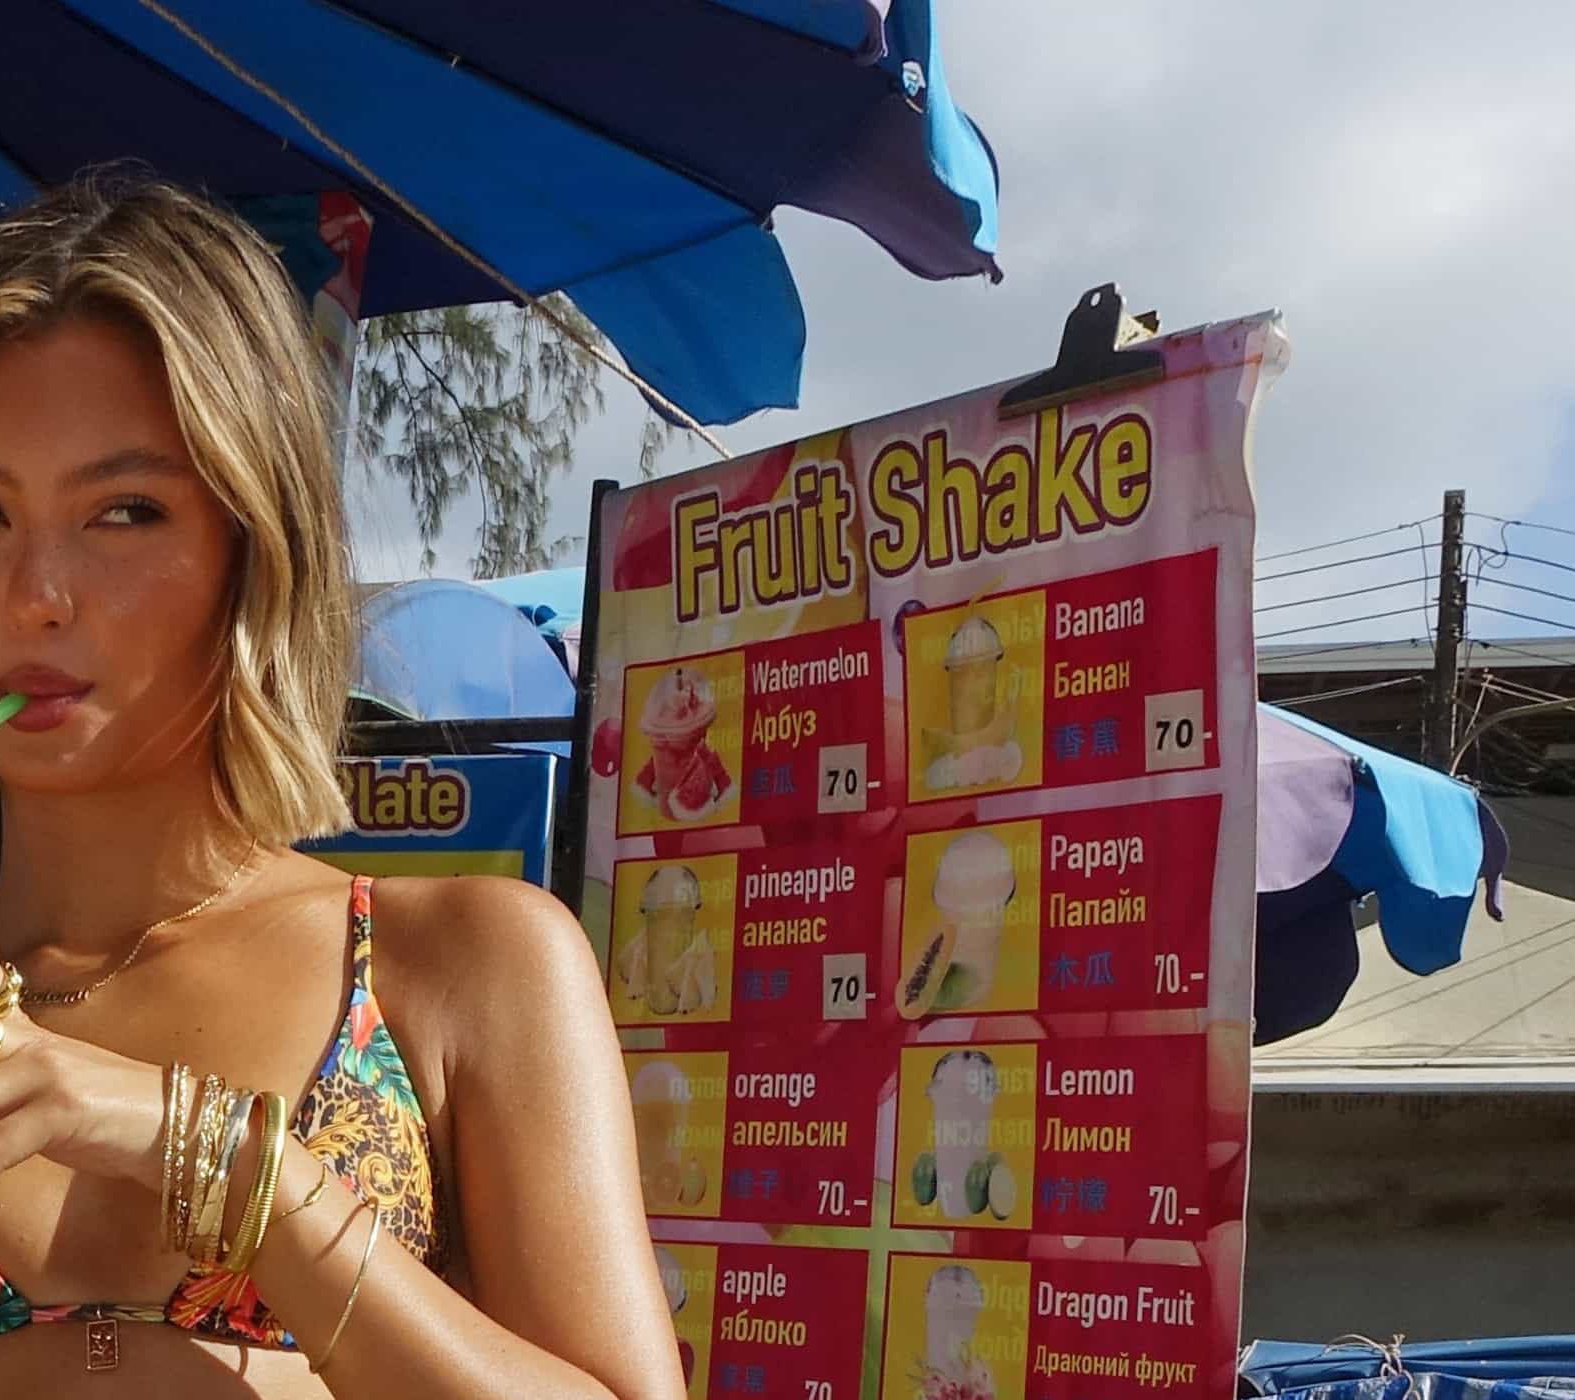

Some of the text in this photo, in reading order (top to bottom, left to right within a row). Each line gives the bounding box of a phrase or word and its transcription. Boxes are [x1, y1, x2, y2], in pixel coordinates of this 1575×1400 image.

[674, 406, 1152, 624] Fruit Shake
[1055, 596, 1146, 642] Banana
[751, 647, 869, 696] Watermelon
[1054, 660, 1131, 698] Банан
[751, 708, 817, 746] Арбуз
[1049, 835, 1144, 877] Papaya
[745, 860, 856, 908] pineapple
[1049, 892, 1146, 928] Папайя
[742, 918, 826, 947] ананас
[1154, 955, 1205, 995] 70.-
[734, 1069, 816, 1105] orange
[1045, 1062, 1134, 1098] Lemon
[733, 1116, 847, 1148] апельсин
[1043, 1118, 1131, 1152] Лимон
[817, 1180, 867, 1216] 70.-
[1149, 1186, 1199, 1226] 70.-
[723, 1262, 786, 1300] apple
[1037, 1282, 1195, 1328] Dragon Fruit
[721, 1311, 806, 1348] яблоко
[1034, 1344, 1196, 1387] Драконий фрукт
